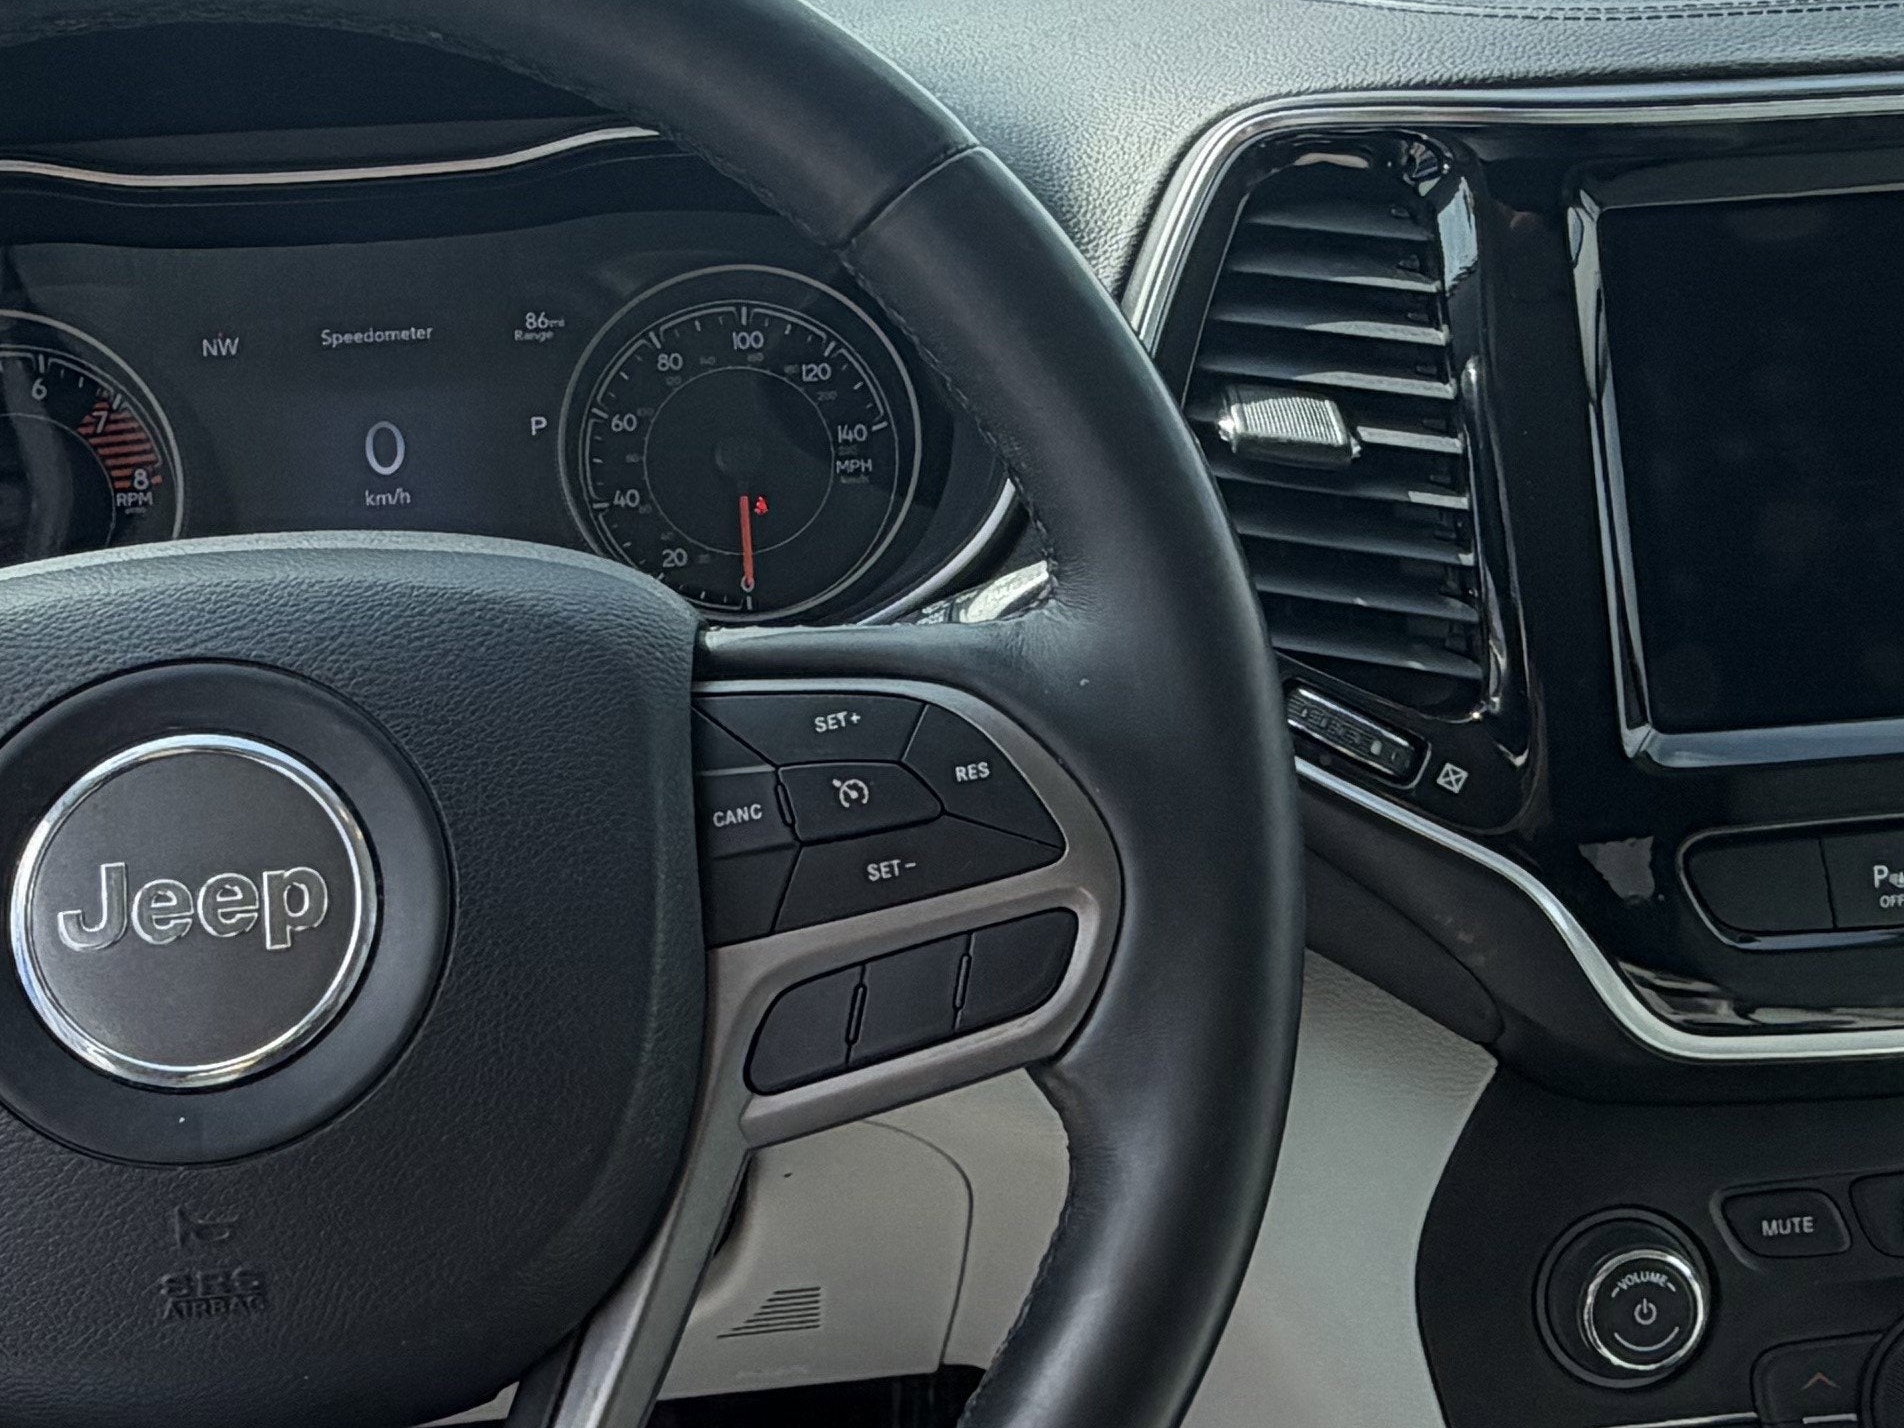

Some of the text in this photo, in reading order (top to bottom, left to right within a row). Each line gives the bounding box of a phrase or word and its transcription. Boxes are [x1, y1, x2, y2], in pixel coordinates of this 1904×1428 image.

[202, 336, 239, 357] NW
[320, 325, 434, 349] Speedometer
[514, 329, 554, 343] Range
[732, 330, 765, 350] 100
[657, 352, 684, 371] 80
[801, 362, 832, 382] 120
[31, 377, 47, 400] 6
[94, 410, 108, 433] 7
[530, 416, 547, 436] P
[611, 412, 638, 432] 60
[837, 423, 868, 443] 140
[365, 421, 406, 476] 0
[836, 458, 873, 474] MPH
[133, 468, 149, 490] 8
[116, 491, 153, 507] RPM
[365, 487, 411, 507] km/h
[613, 488, 640, 508] 40
[662, 547, 688, 568] 20
[813, 710, 862, 733] SET+
[954, 761, 991, 783] RES
[712, 803, 763, 828] CANC
[56, 861, 329, 952] Jeep
[1761, 1215, 1815, 1236] MUTE
[1616, 1272, 1669, 1291] VOLUME
[162, 1294, 266, 1320] AIRBAG
